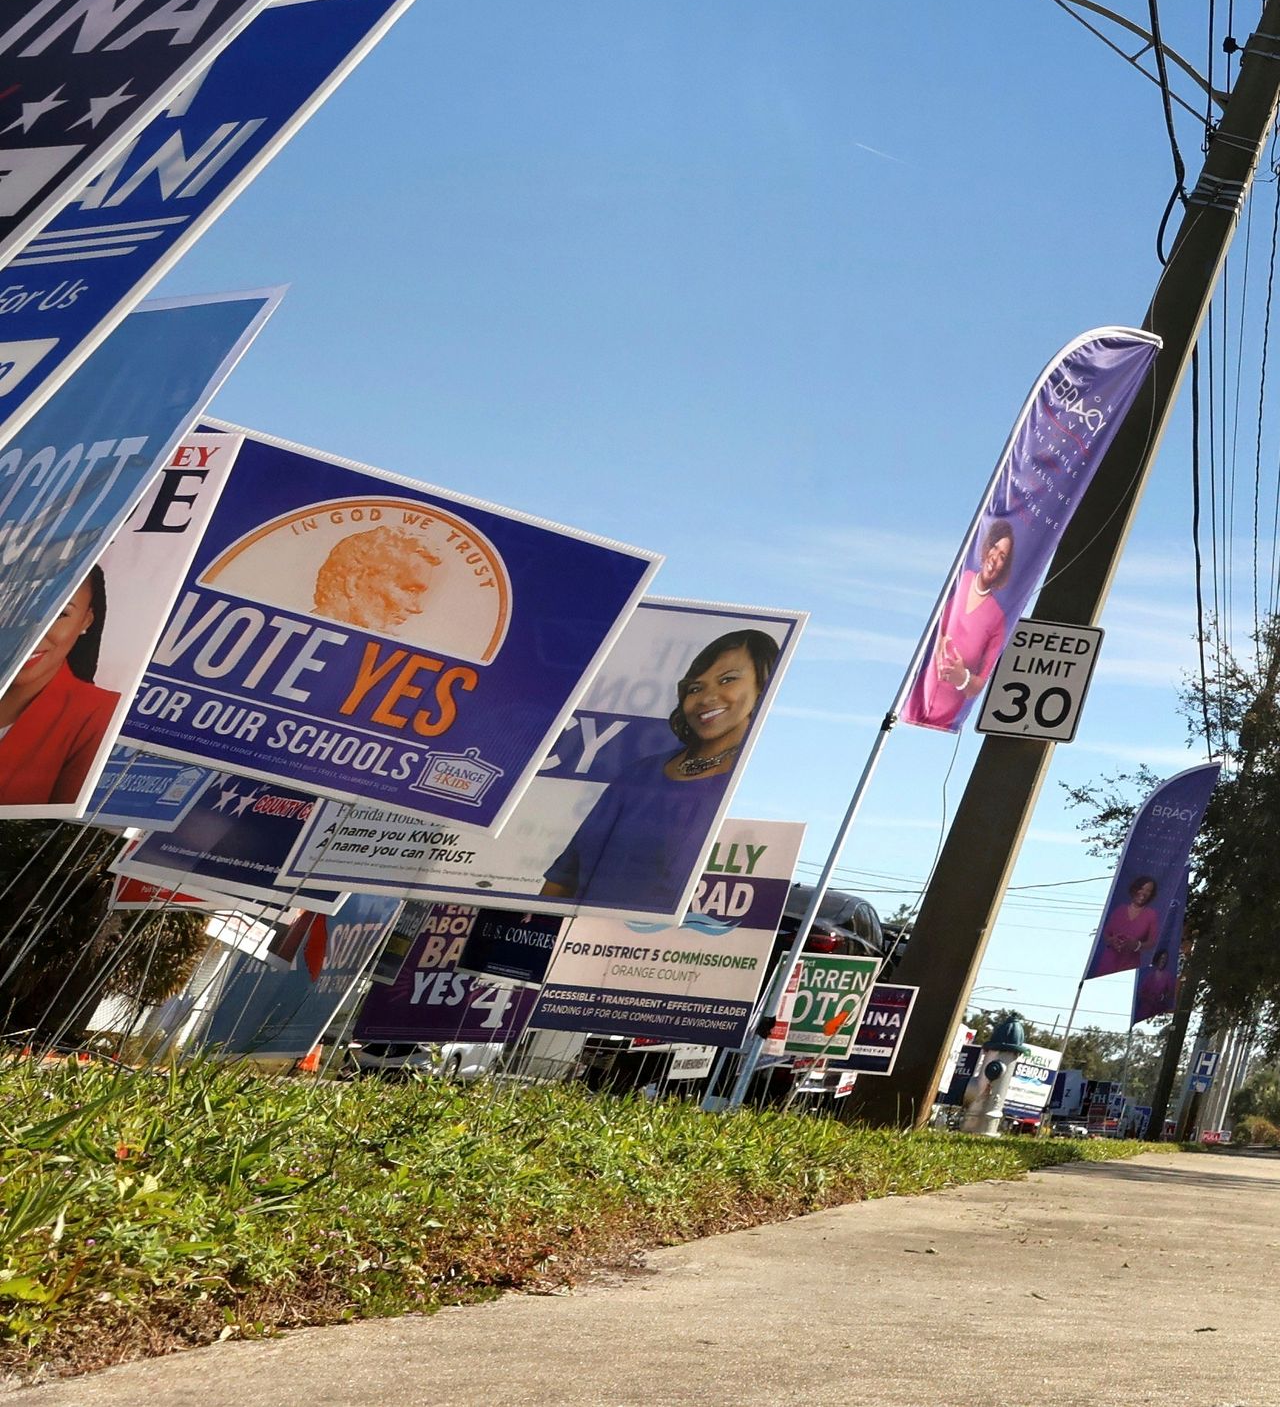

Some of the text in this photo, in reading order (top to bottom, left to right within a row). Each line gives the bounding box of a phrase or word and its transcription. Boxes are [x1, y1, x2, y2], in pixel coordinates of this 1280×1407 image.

[39, 278, 89, 312] Us
[1053, 375, 1107, 438] BRACY
[290, 508, 497, 589] IN GOD WE TRUST
[1013, 631, 1091, 655] SPEED
[152, 591, 479, 738] VOTE YES
[1012, 655, 1077, 678] LIMIT
[991, 682, 1072, 728] 30
[191, 700, 267, 742] OUR
[266, 720, 420, 781] SCHOOLS
[253, 794, 304, 818] COUNTY
[336, 802, 384, 823] Forida
[1152, 804, 1198, 822] BRACY
[323, 822, 460, 847] A name you KNOW.
[316, 837, 476, 865] A name you can TRUST.
[706, 842, 768, 875] LLY
[692, 879, 755, 917] RAD
[320, 922, 384, 971] SCOTT
[562, 941, 758, 971] FOR DISTRICT 5 COMMISSIONER
[611, 964, 702, 983] ORANGE COUNTY
[799, 968, 871, 992] ARREN
[410, 971, 471, 1007] YES
[541, 988, 748, 1018] ACCESSIBLE TRANSPARENT EFFECTIVE LEADER
[470, 982, 514, 1029] 4
[541, 1003, 582, 1016] STANDING
[583, 1007, 593, 1017] UP
[594, 1008, 611, 1019] FOR
[612, 1010, 629, 1020] OUR
[629, 1011, 675, 1025] COMMUNITY
[681, 1016, 739, 1032] ENVIRONMENT
[1015, 1063, 1050, 1082] SEMRAD
[1195, 1052, 1217, 1076] H
